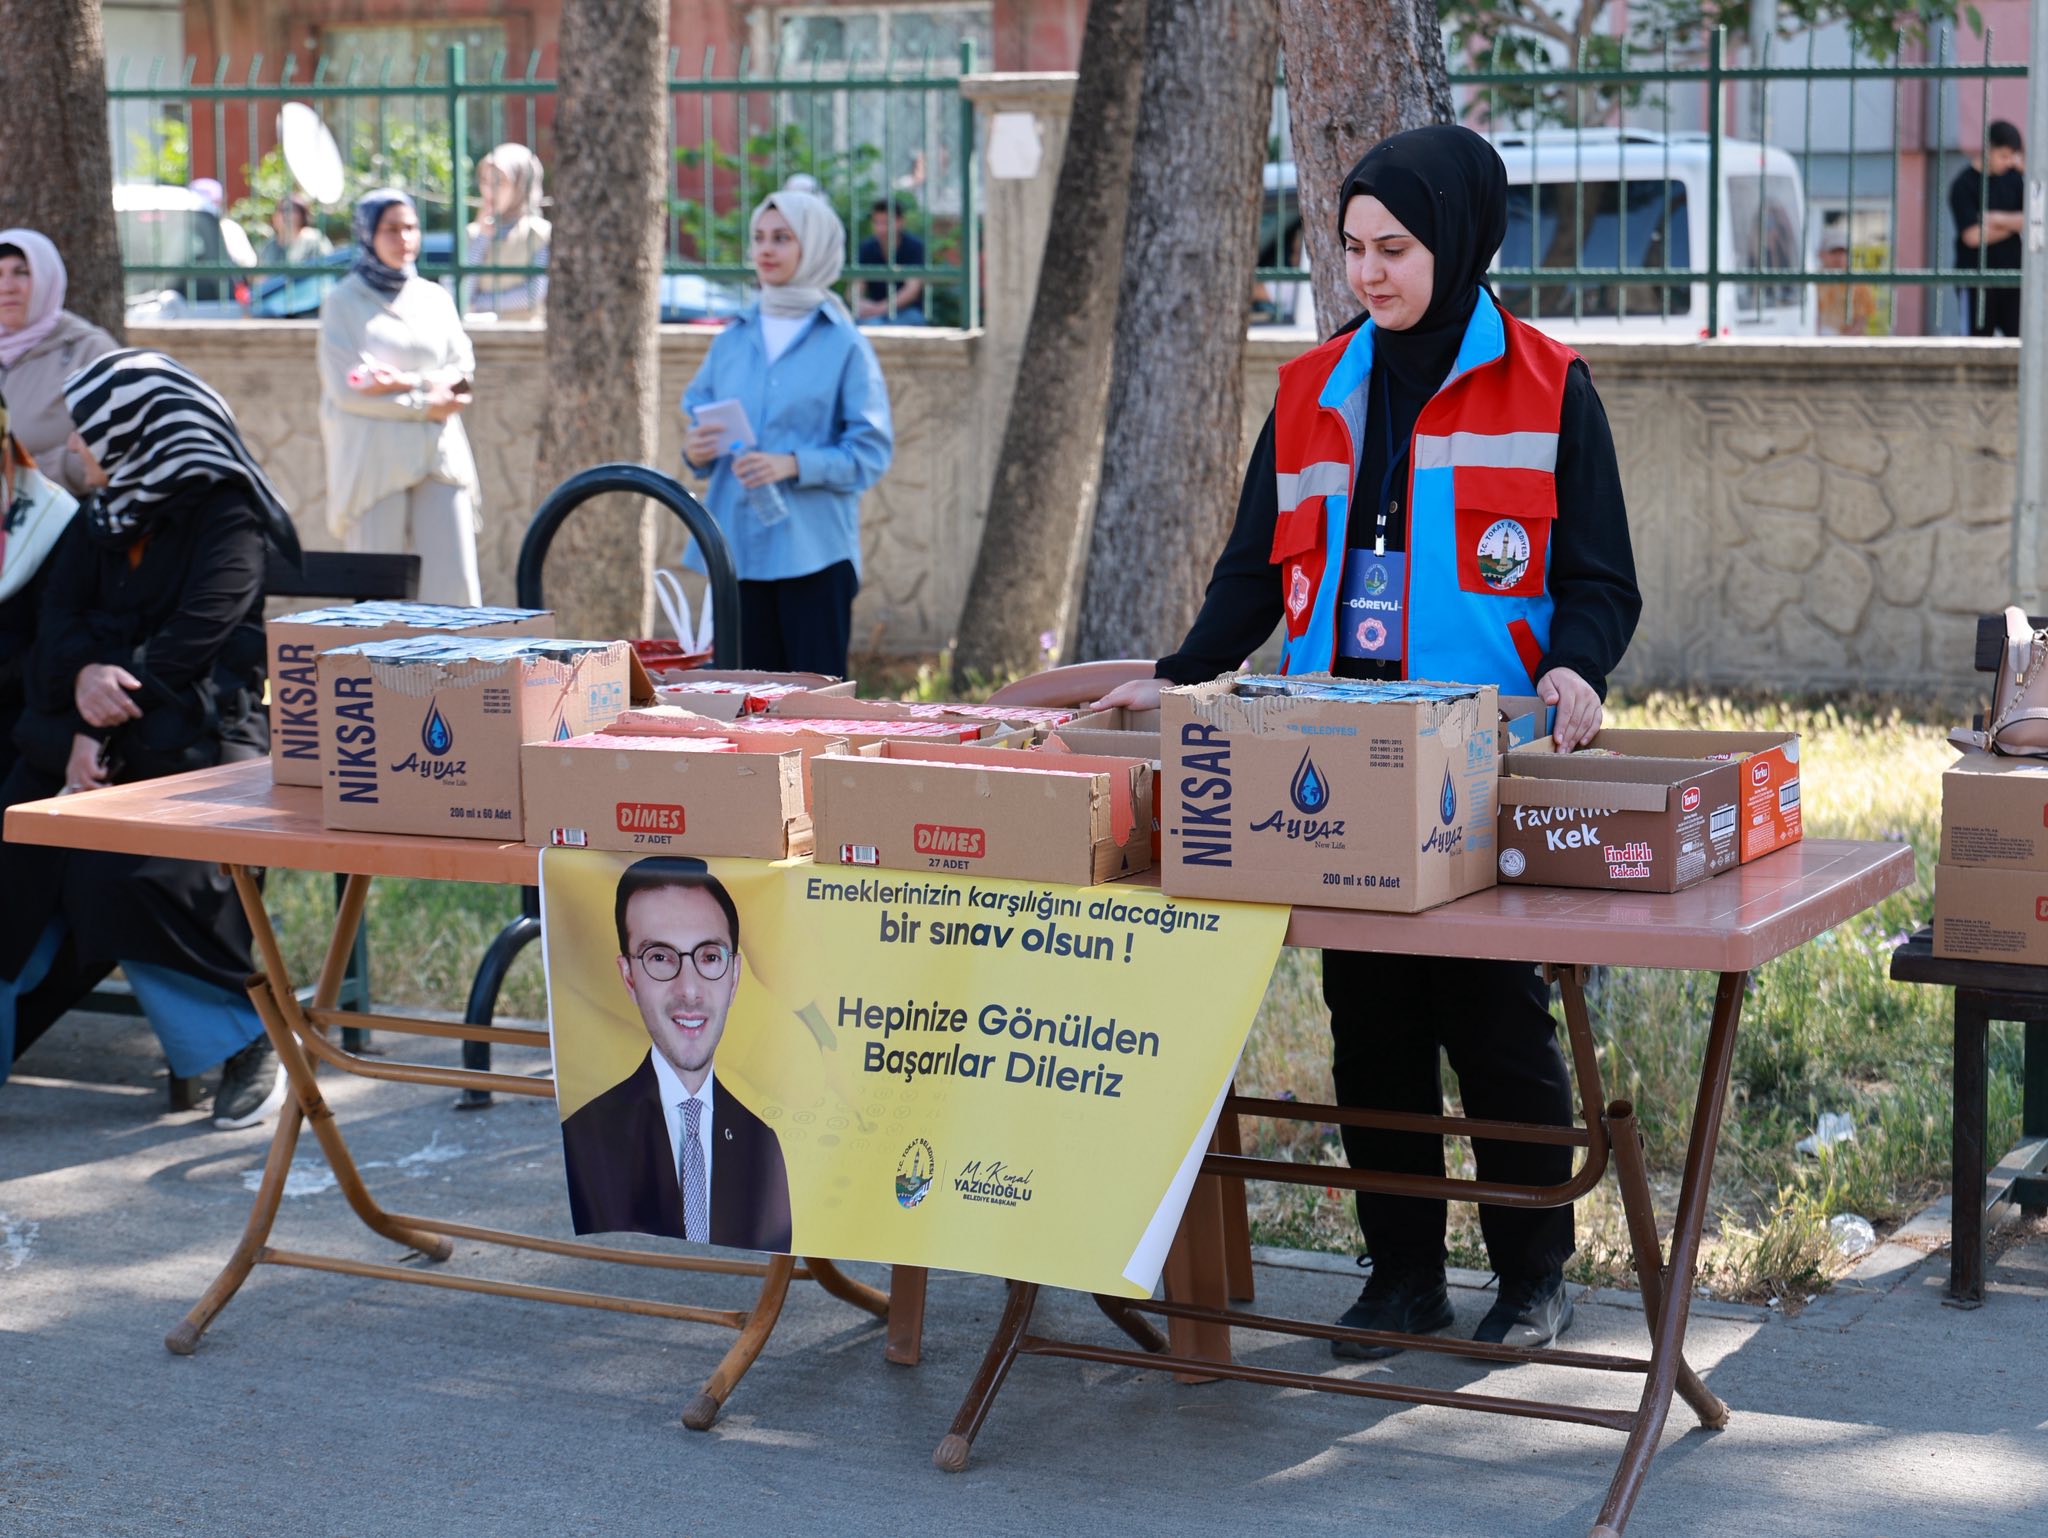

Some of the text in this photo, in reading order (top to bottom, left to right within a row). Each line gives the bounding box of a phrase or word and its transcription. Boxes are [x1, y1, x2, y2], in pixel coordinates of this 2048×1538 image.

[1485, 522, 1505, 541] TOKAT
[1350, 598, 1398, 612] GÖREVLİ
[273, 644, 320, 760] NİKSAR
[329, 676, 379, 804] NİKSAR
[1170, 723, 1233, 868] NİKSAR
[1683, 793, 1698, 807] Torku
[450, 808, 464, 818] 200
[466, 809, 475, 818] ml
[483, 809, 493, 819] 60
[495, 809, 512, 820] Adet
[621, 805, 680, 829] DİMES
[634, 834, 672, 845] 27 ADET
[918, 827, 981, 853] DİMES
[1545, 823, 1600, 851] Kek
[1604, 842, 1652, 862] Fındıklı
[928, 858, 969, 870] 27 ADET
[1609, 863, 1650, 879] Kakaolu
[1322, 873, 1400, 888] 200 ml x 60 Adet
[807, 878, 1220, 934] Emeklerinizin karşılığını alacağınız
[880, 910, 1134, 964] bir sınav olsun !
[837, 996, 1160, 1057] Hepinize Gönülden
[863, 1041, 1123, 1098] Başarılar Dileriz
[902, 1138, 919, 1158] TOKAT
[960, 1160, 1034, 1186] M. Kemal
[954, 1178, 1033, 1201] YAZICIOĞLU
